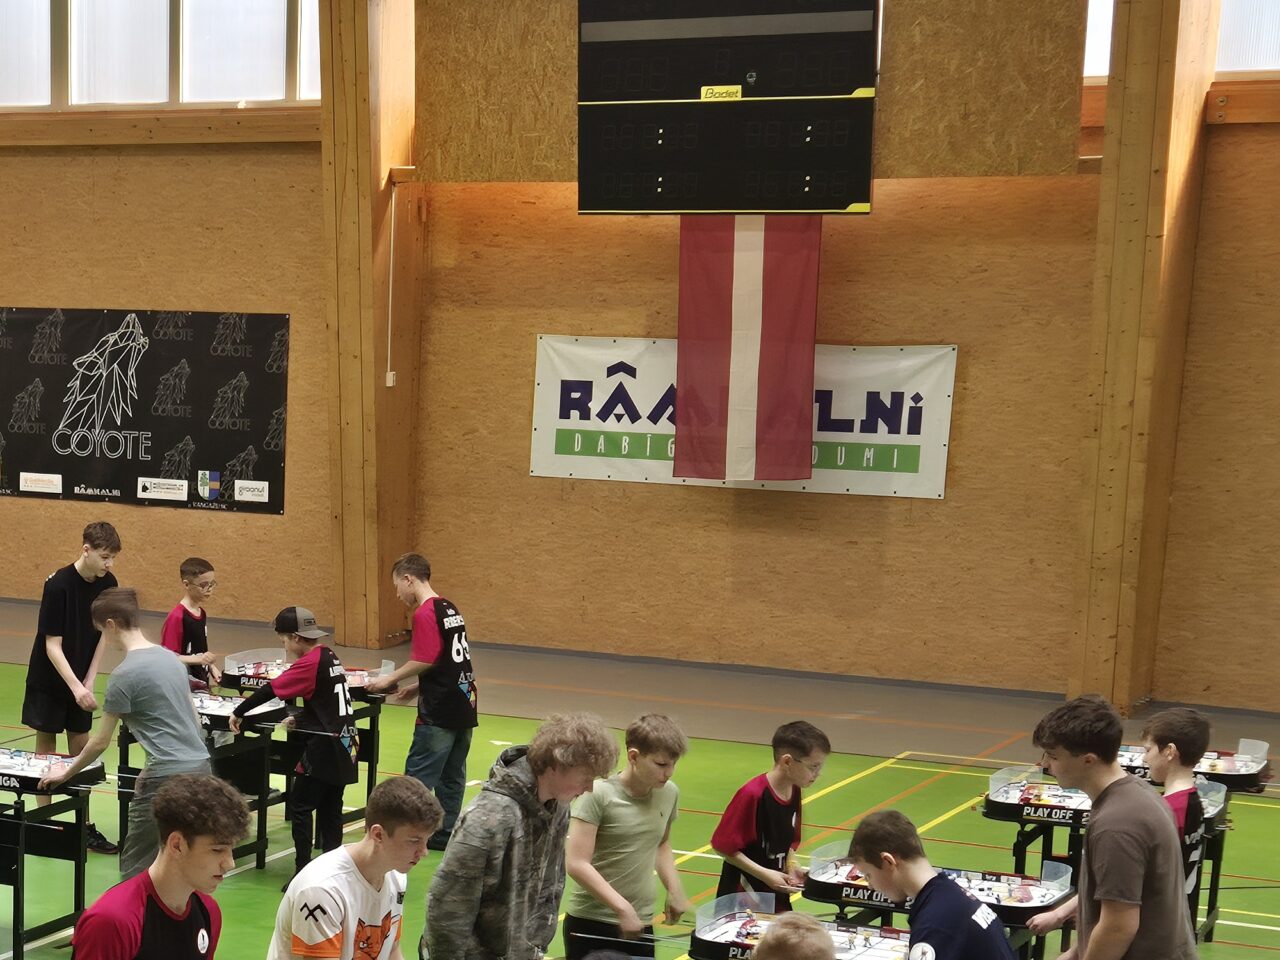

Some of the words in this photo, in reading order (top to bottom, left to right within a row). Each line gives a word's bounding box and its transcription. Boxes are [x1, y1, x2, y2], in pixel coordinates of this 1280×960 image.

[703, 87, 739, 99] Bodet
[152, 328, 194, 340] COYOTE
[210, 344, 253, 357] COYOTE
[28, 353, 68, 365] COYOTE
[151, 404, 193, 417] COYOTE
[8, 422, 46, 434] COYOTE
[208, 418, 251, 431] COYOTE
[51, 427, 152, 461] COYOTE
[240, 677, 258, 685] PLAY
[1022, 806, 1050, 818] PLAY
[1051, 809, 1073, 821] OFF
[842, 886, 871, 899] PLAY
[728, 947, 754, 960] PLA
